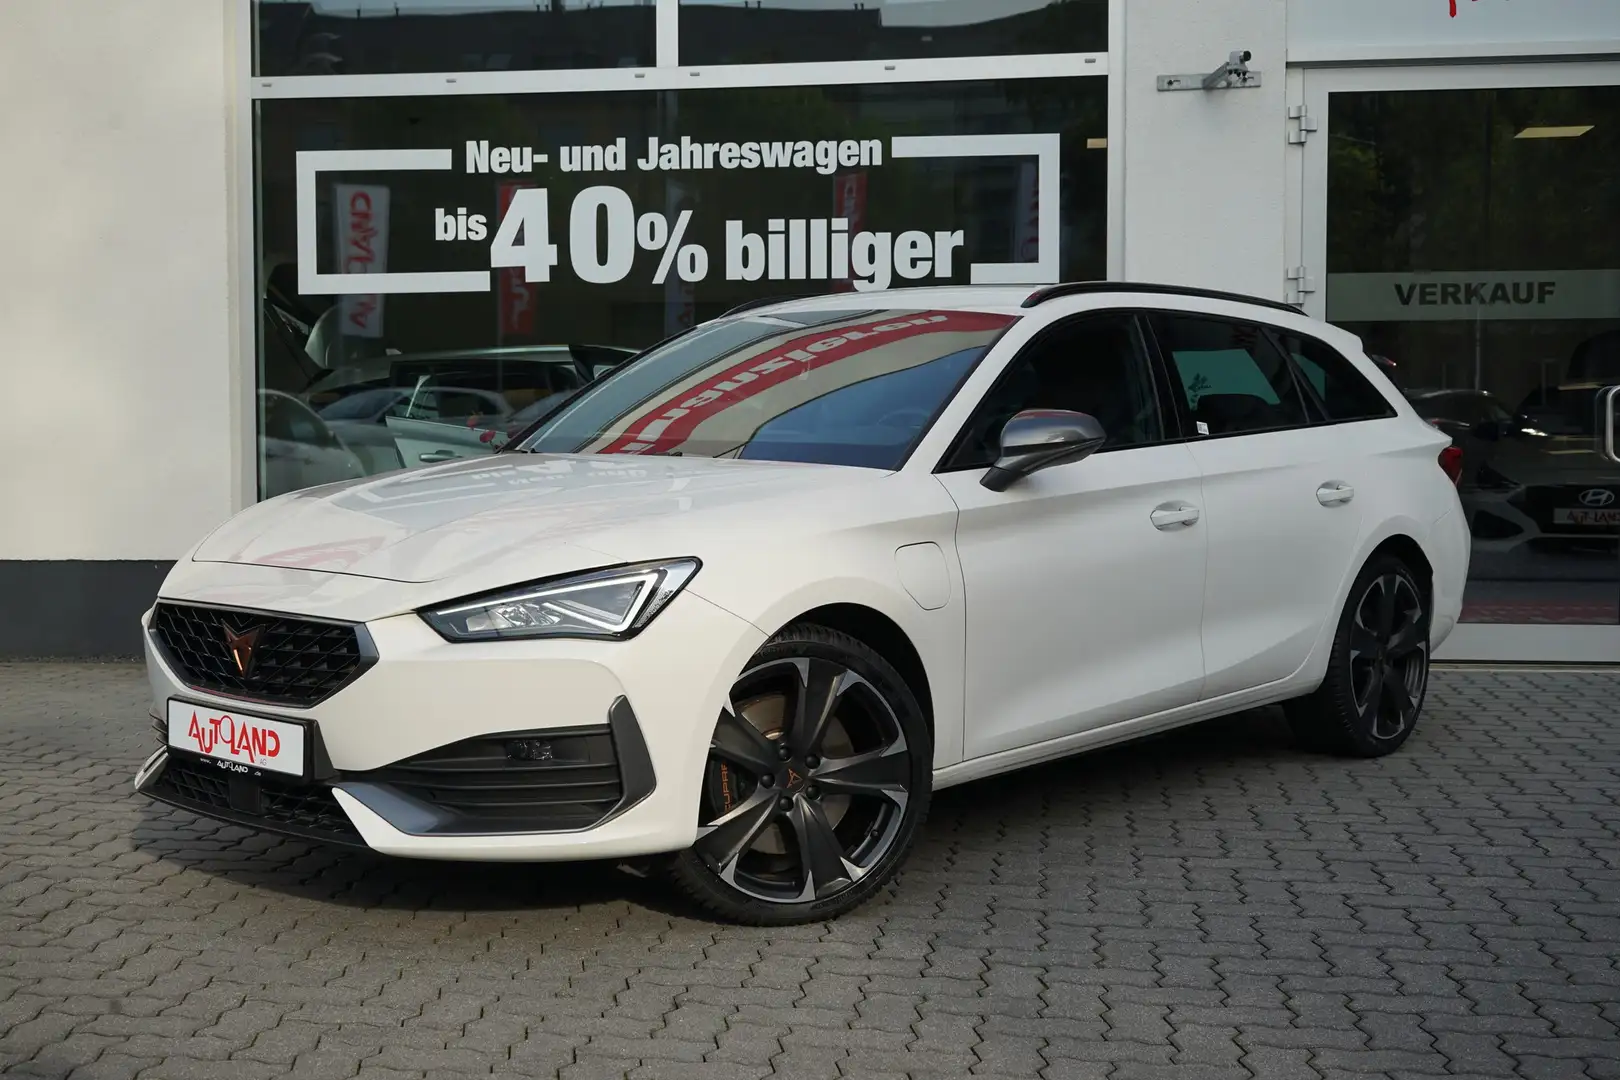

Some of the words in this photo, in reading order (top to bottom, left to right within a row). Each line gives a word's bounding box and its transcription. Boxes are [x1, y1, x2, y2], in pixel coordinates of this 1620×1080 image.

[466, 141, 548, 173] Neu-
[560, 138, 625, 171] und
[638, 136, 881, 174] Jahreswagen
[436, 208, 487, 241] bis
[490, 185, 709, 284] 40%
[726, 218, 963, 292] billiger
[1394, 281, 1556, 306] VERKAUF
[188, 710, 280, 763] AUTOLAND
